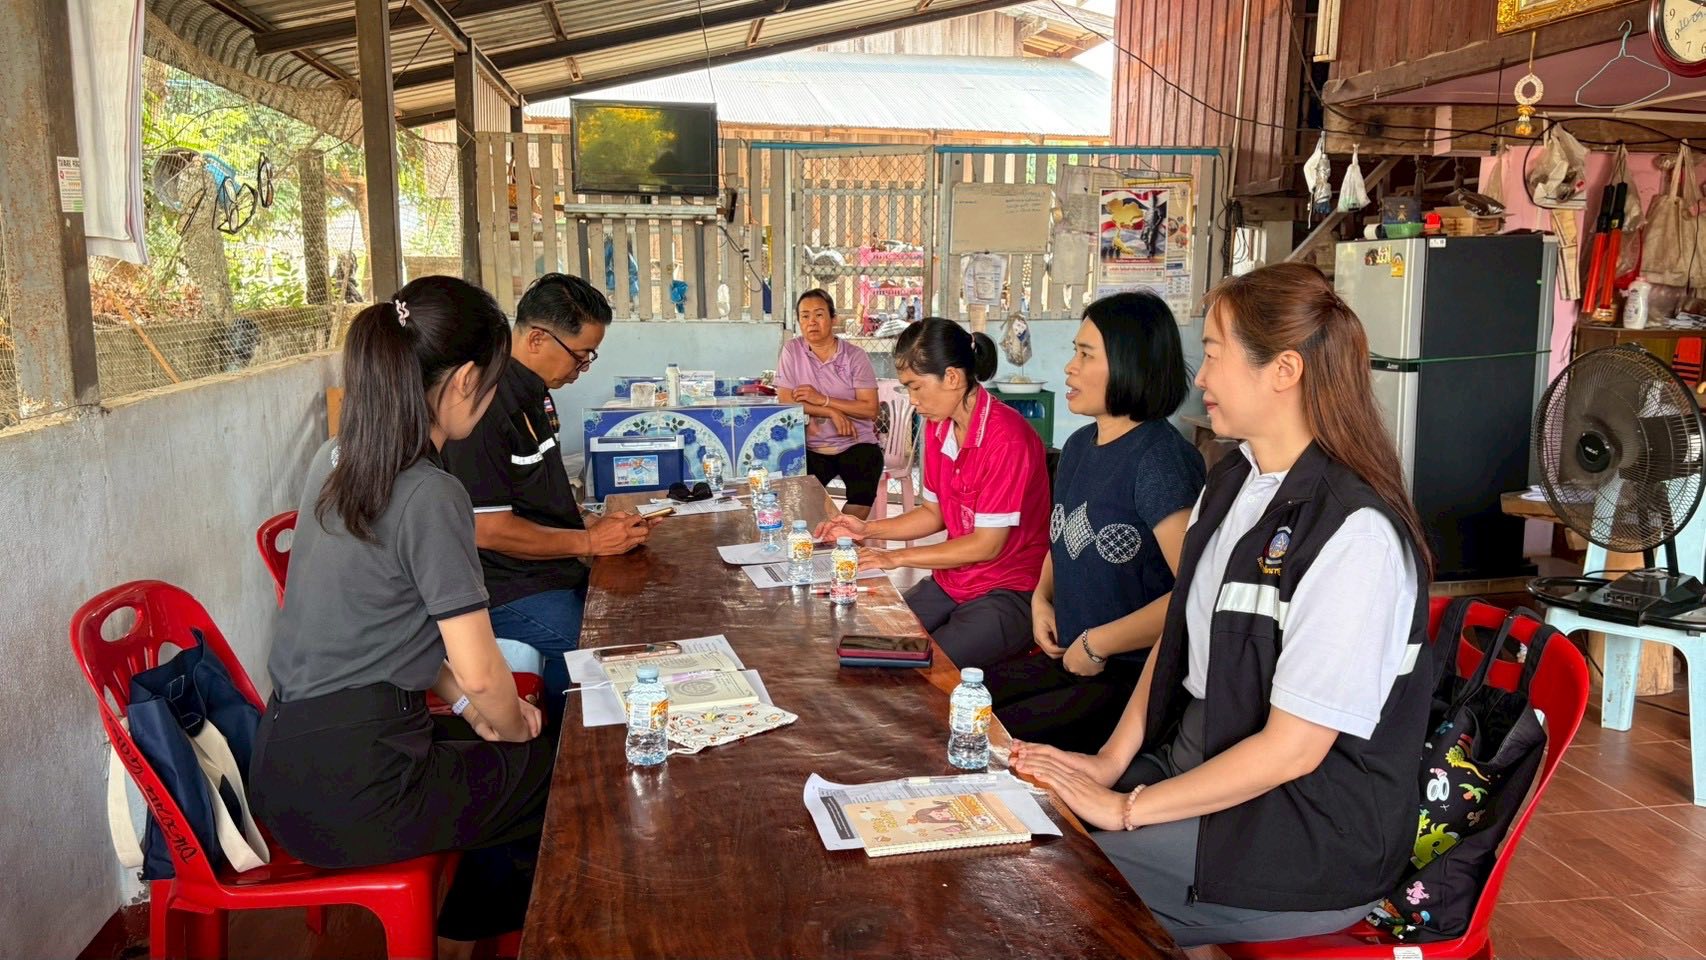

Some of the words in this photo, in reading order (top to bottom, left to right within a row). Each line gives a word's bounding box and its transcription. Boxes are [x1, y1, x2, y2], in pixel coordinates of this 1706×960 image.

[1669, 8, 1675, 20] 9
[1674, 28, 1680, 40] 8
[1686, 41, 1691, 52] 7
